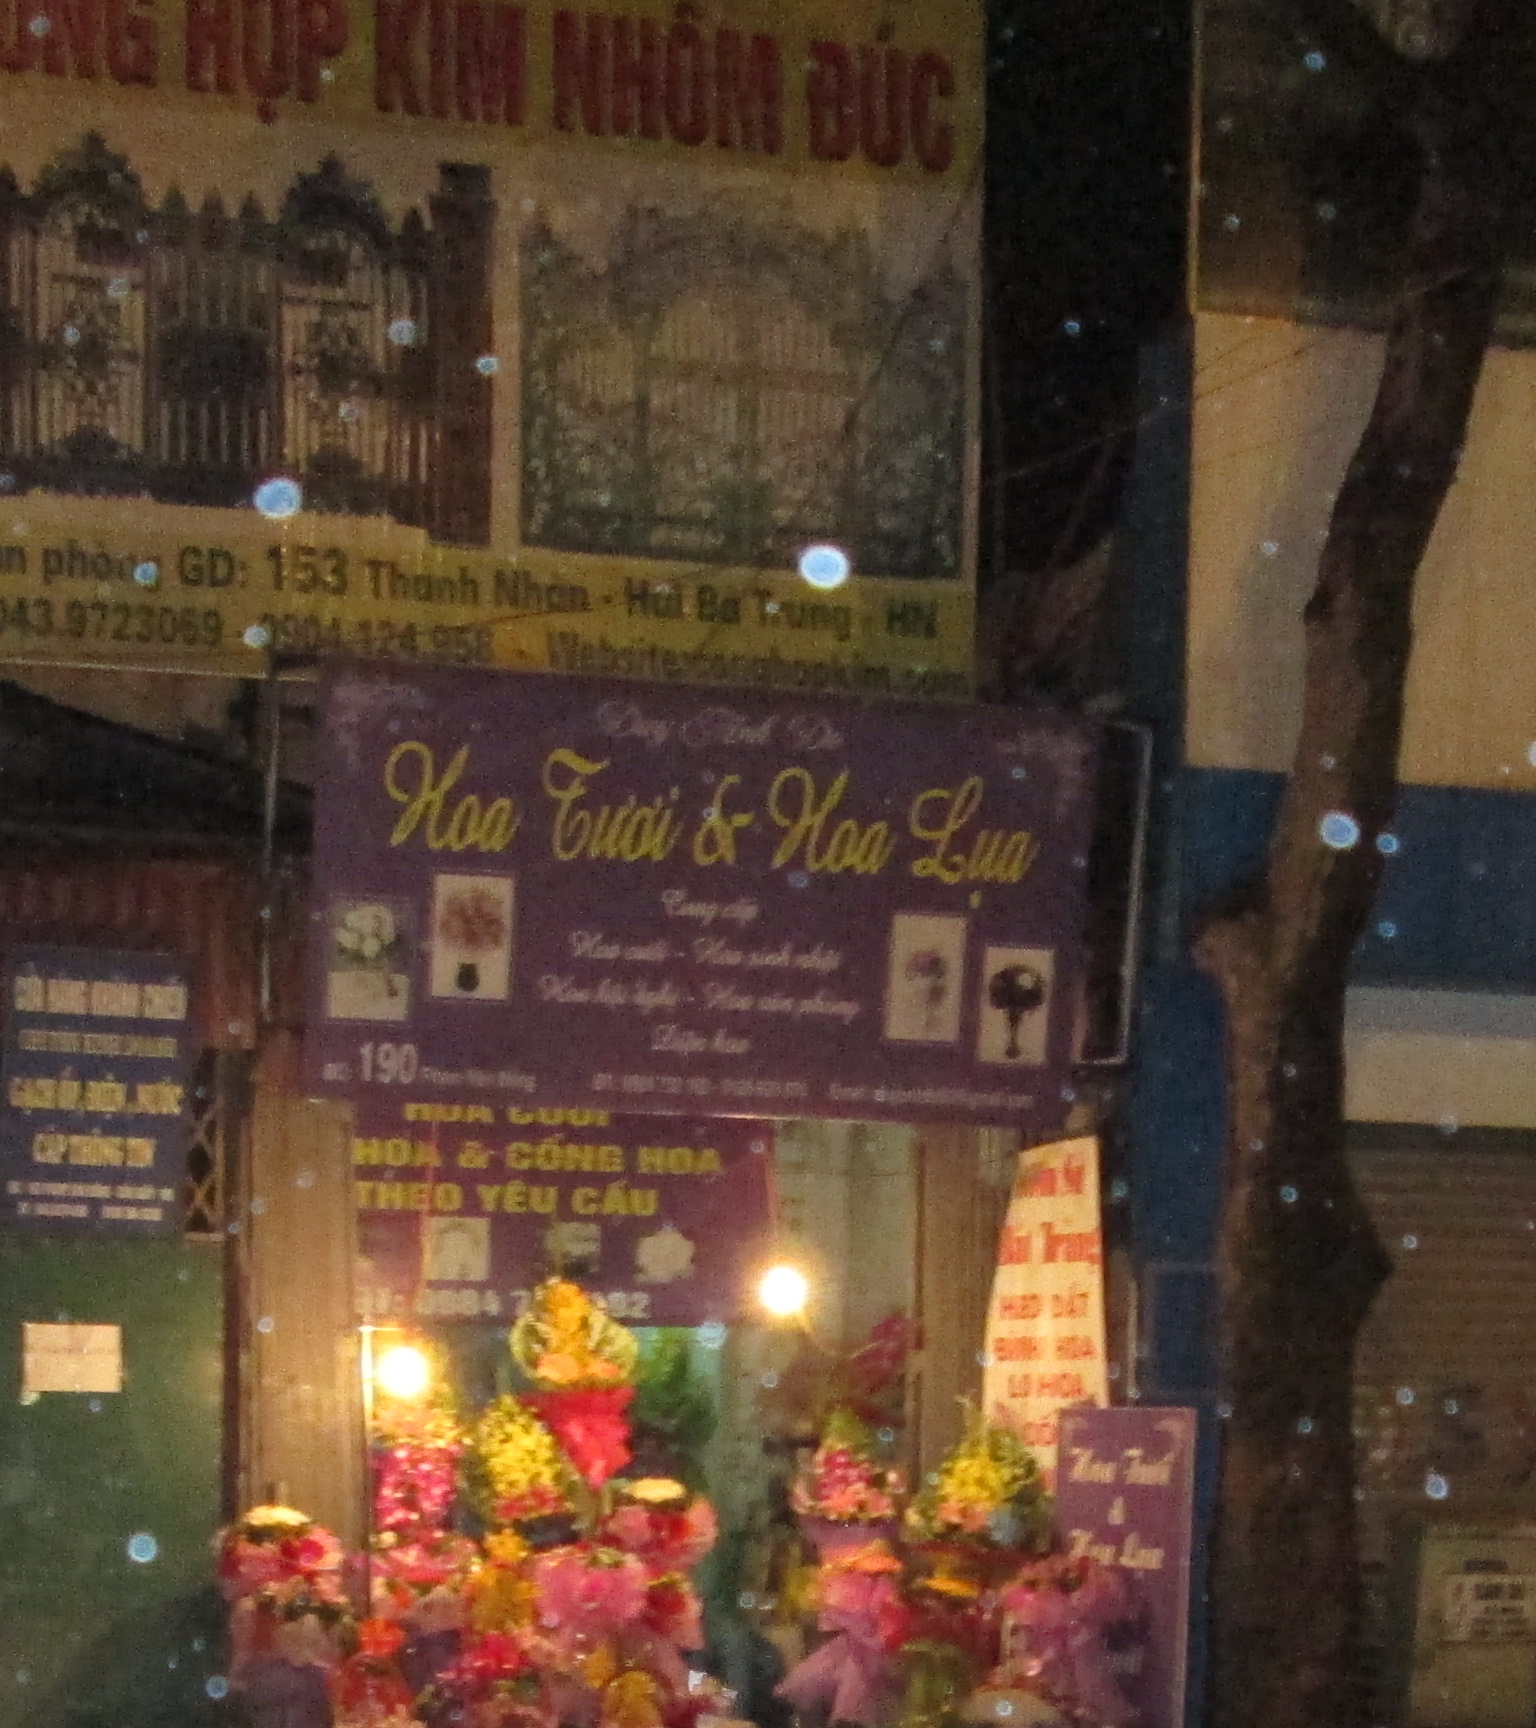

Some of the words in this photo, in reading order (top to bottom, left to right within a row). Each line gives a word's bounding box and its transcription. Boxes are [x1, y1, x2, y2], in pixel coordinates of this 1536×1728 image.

[374, 0, 526, 126] KIM
[264, 545, 349, 596] 153
[360, 1040, 420, 1084] 190
